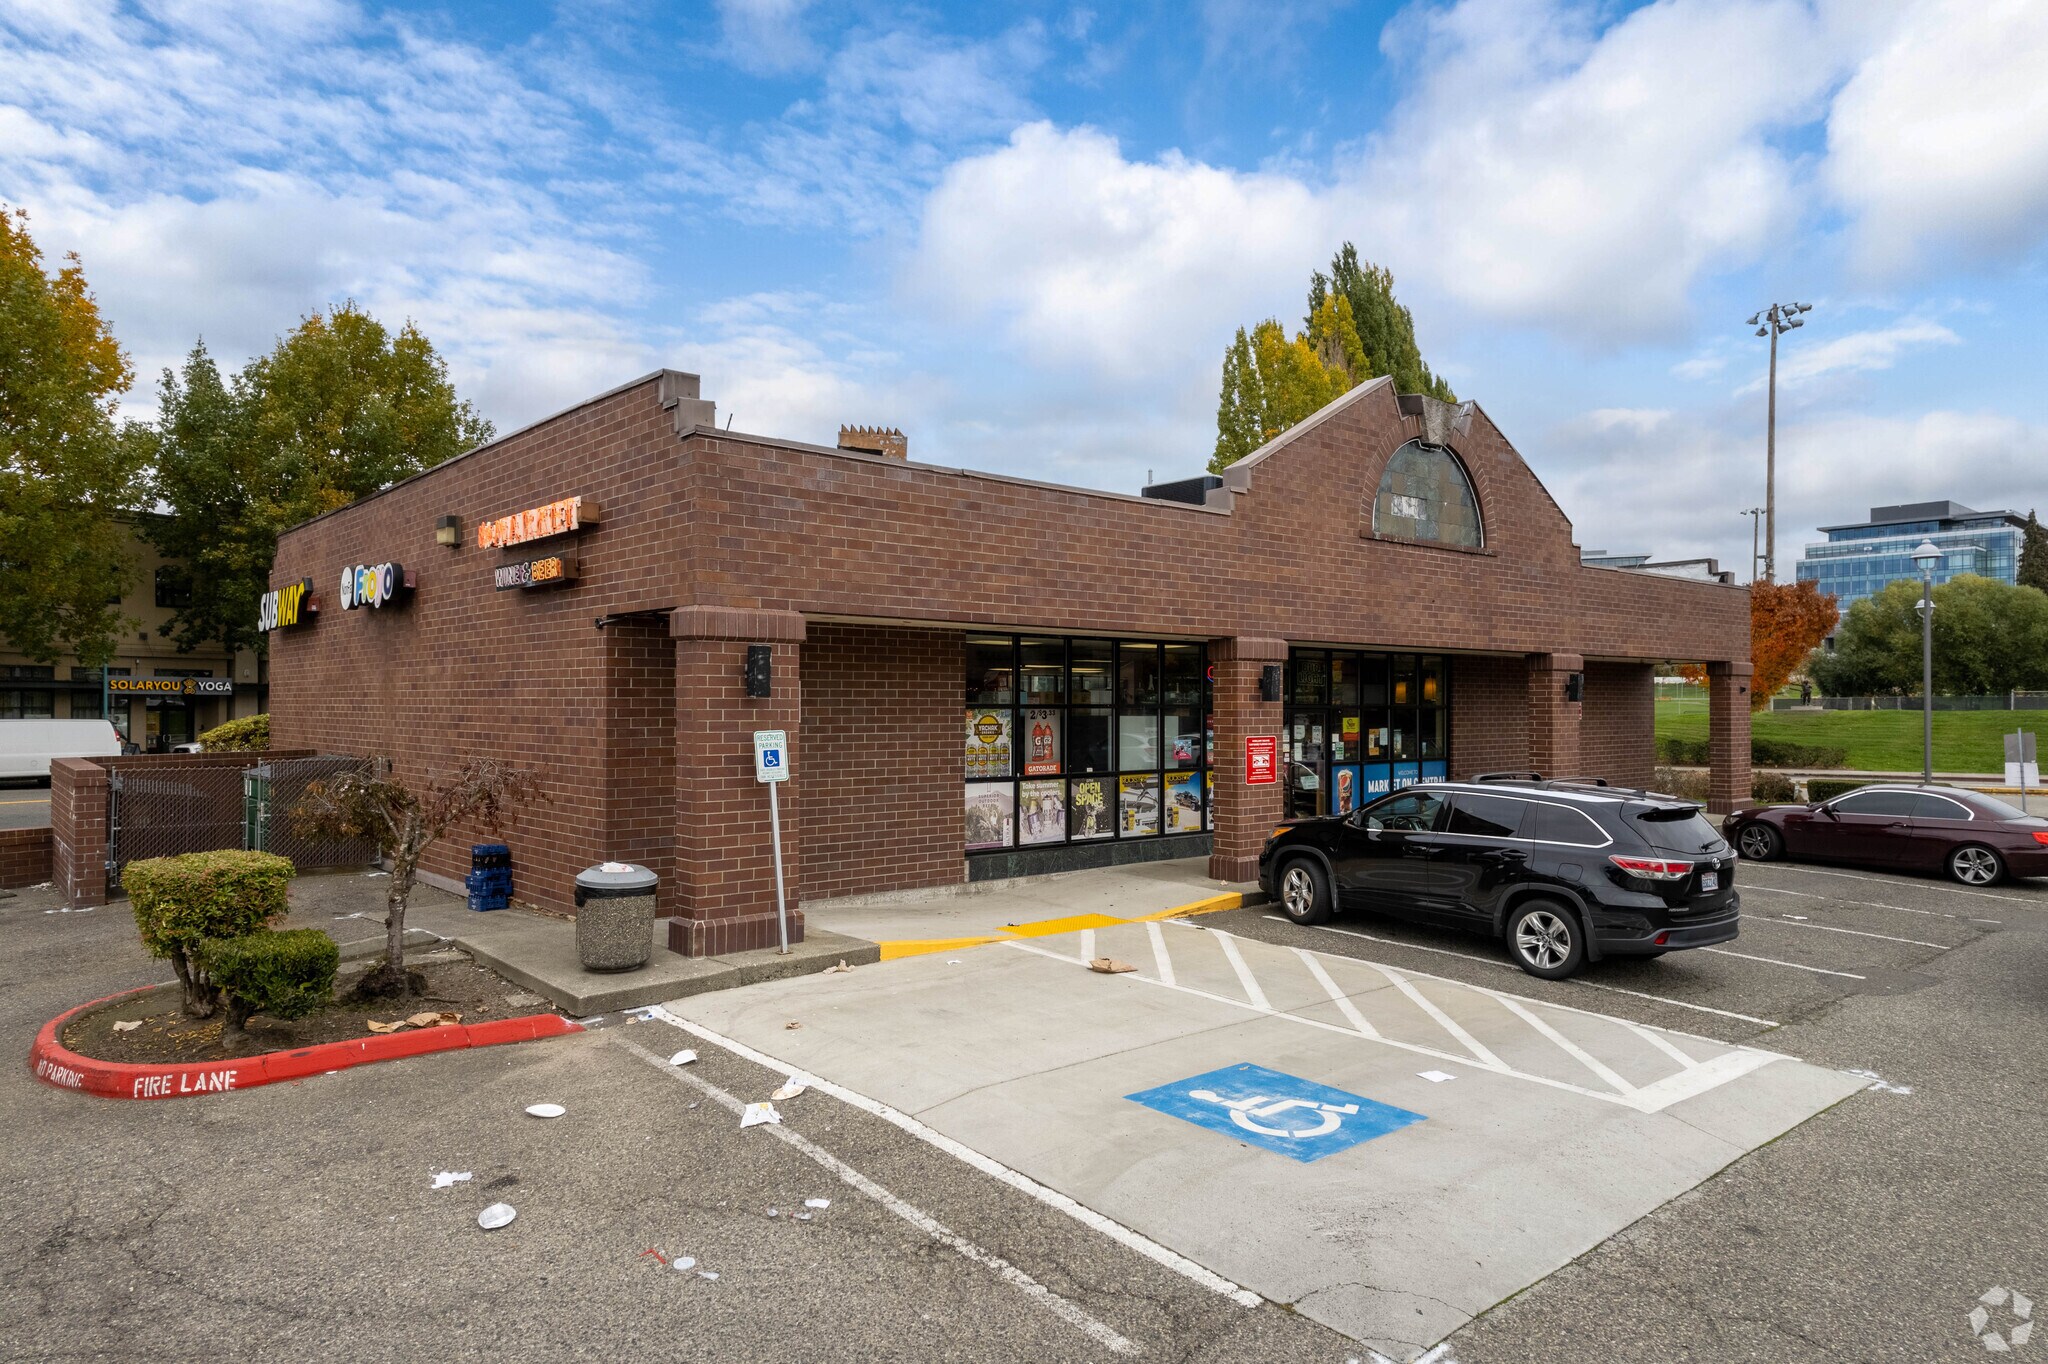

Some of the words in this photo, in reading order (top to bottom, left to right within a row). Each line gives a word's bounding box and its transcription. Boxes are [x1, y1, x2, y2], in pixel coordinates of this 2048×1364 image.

[522, 562, 531, 583] &
[531, 557, 560, 581] BEER
[258, 581, 305, 632] SUBWAY
[110, 680, 181, 690] SOLARYOU
[198, 681, 232, 691] YOGA
[756, 733, 784, 742] RESERVED
[1022, 790, 1029, 799] by
[1080, 782, 1100, 794] OPEN
[1075, 792, 1103, 806] SPACE
[45, 1062, 85, 1088] PARKING
[133, 1074, 174, 1098] FIRE
[180, 1070, 238, 1093] LANE
